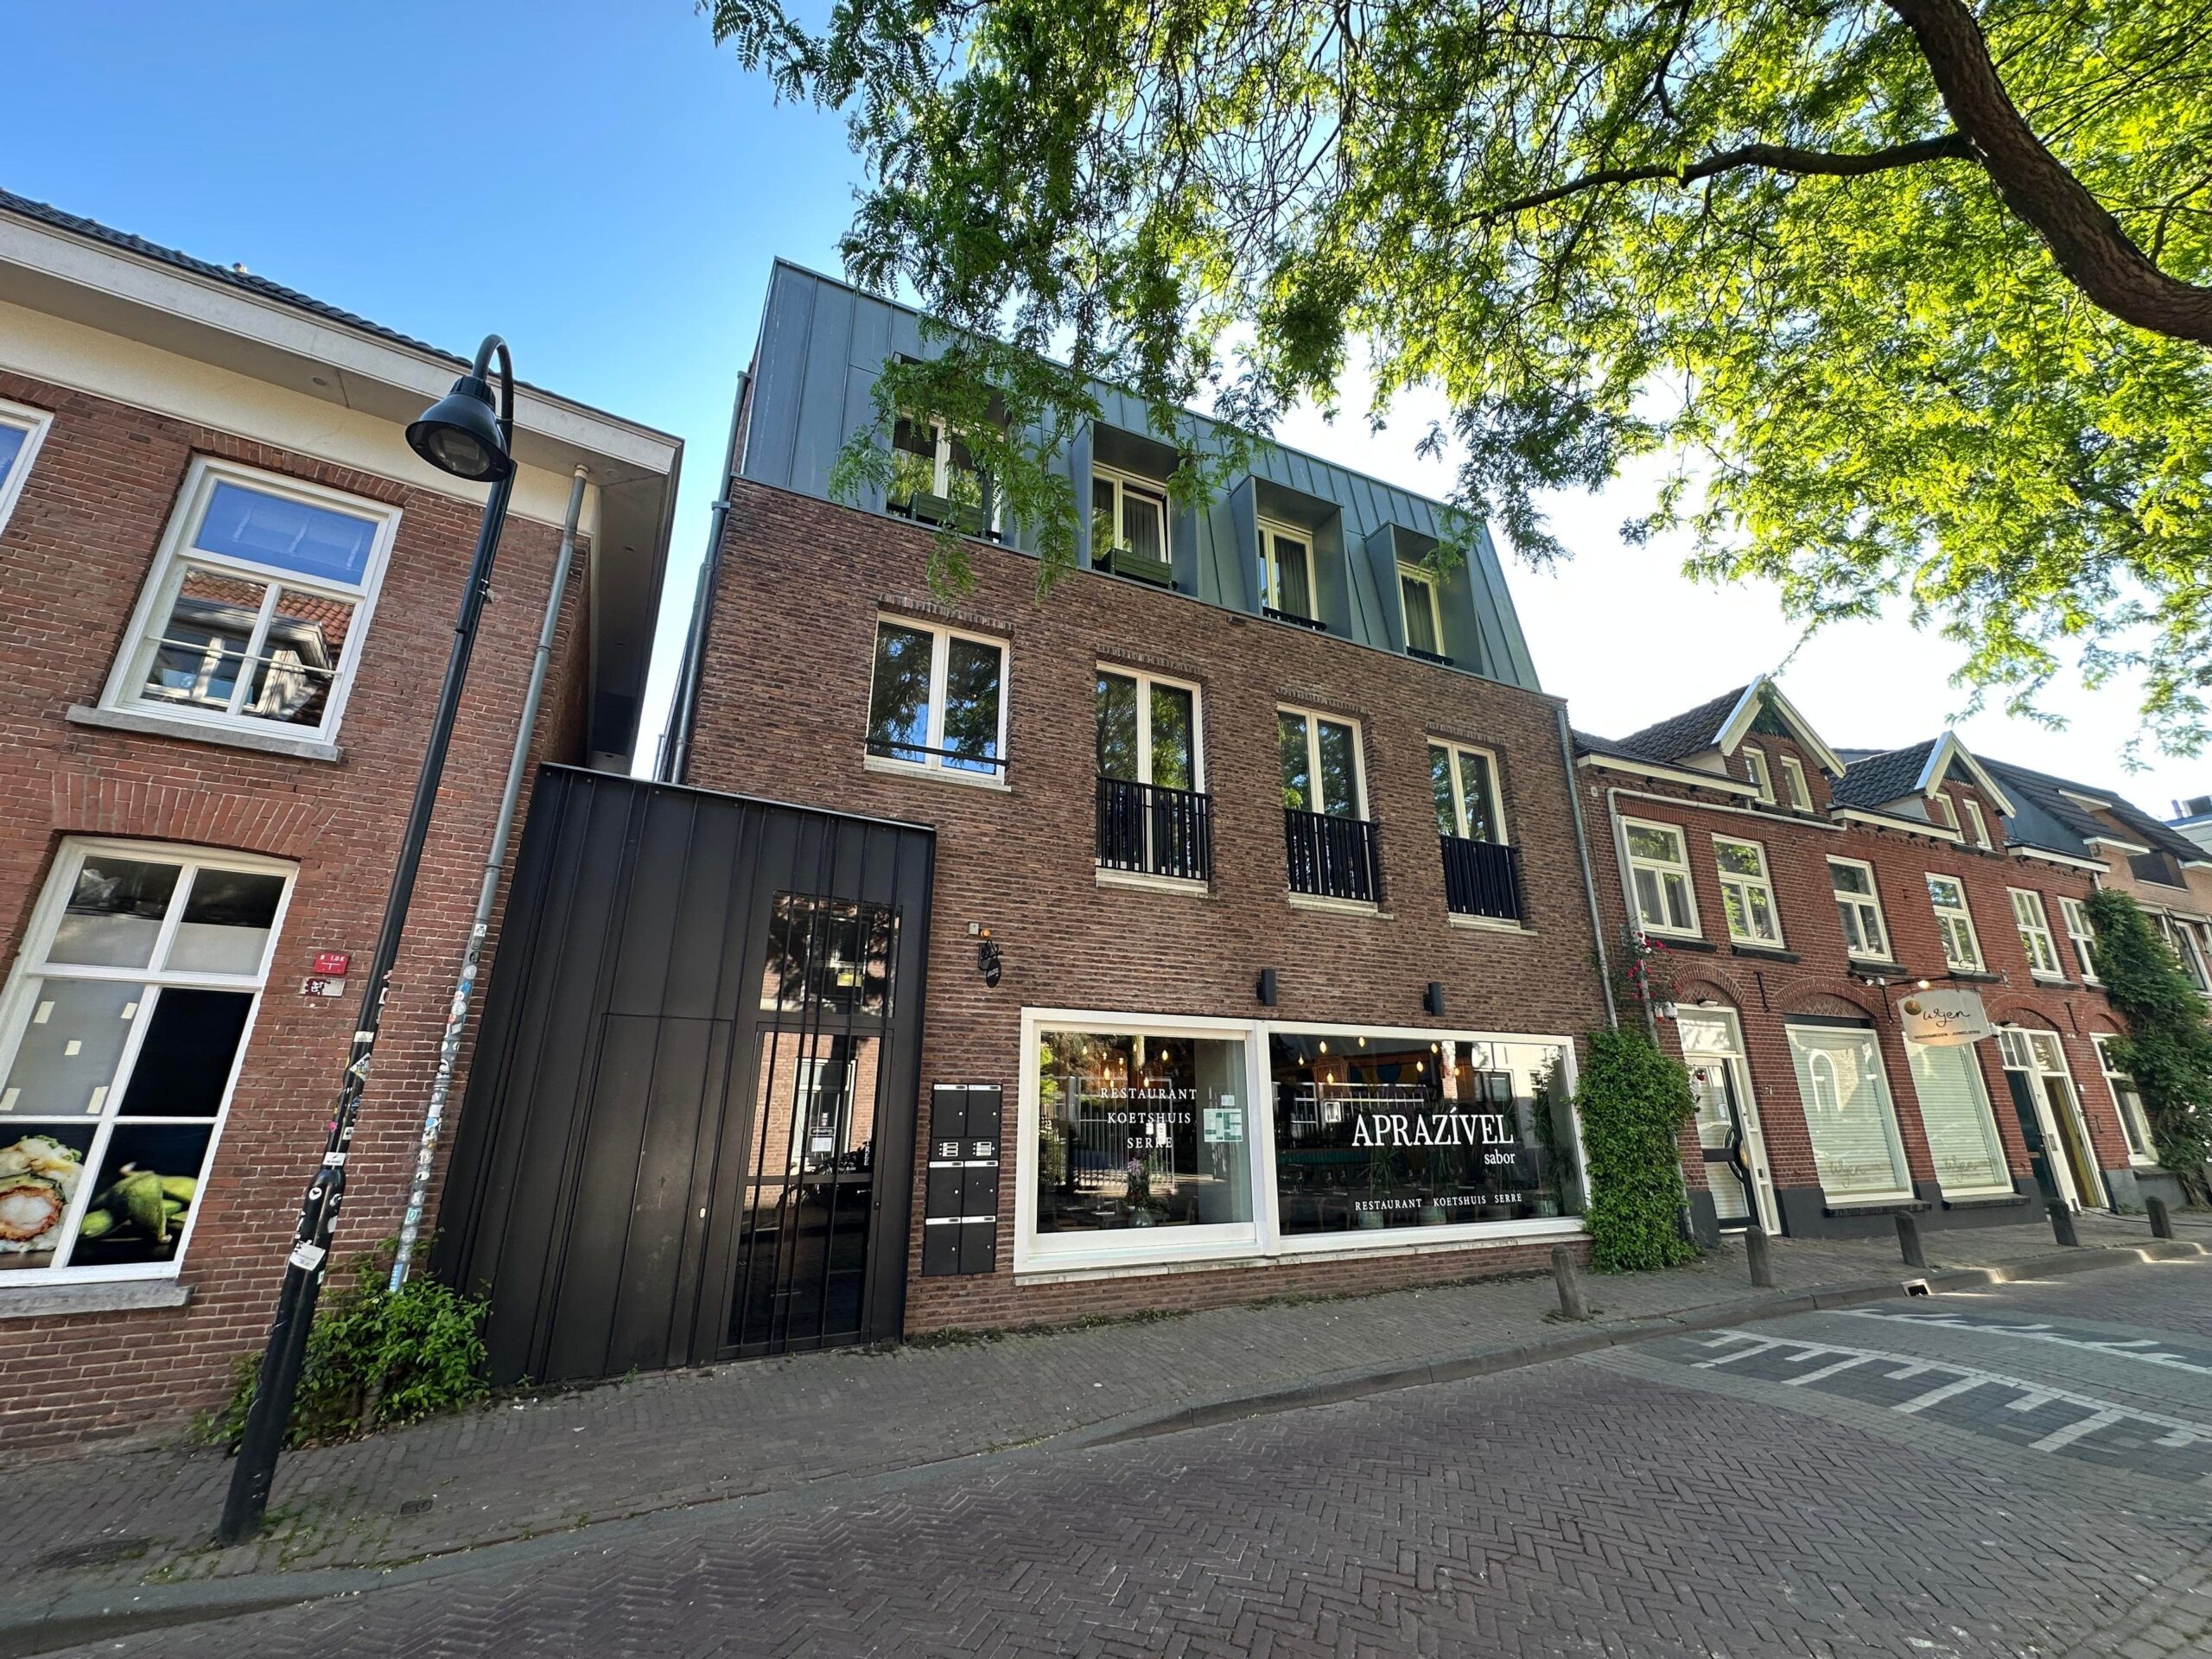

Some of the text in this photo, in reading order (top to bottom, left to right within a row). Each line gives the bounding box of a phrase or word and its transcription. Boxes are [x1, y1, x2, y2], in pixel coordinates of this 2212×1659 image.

[1100, 1087, 1198, 1100] RESTAURANT
[1107, 1112, 1192, 1124] KOETSHUIS
[1351, 1106, 1514, 1147] APRAZÍVEL
[1127, 1136, 1173, 1149] SERRE
[1484, 1148, 1516, 1165] sabor
[1355, 1192, 1522, 1211] RESTAURANT KOETSHUIS SERRE
